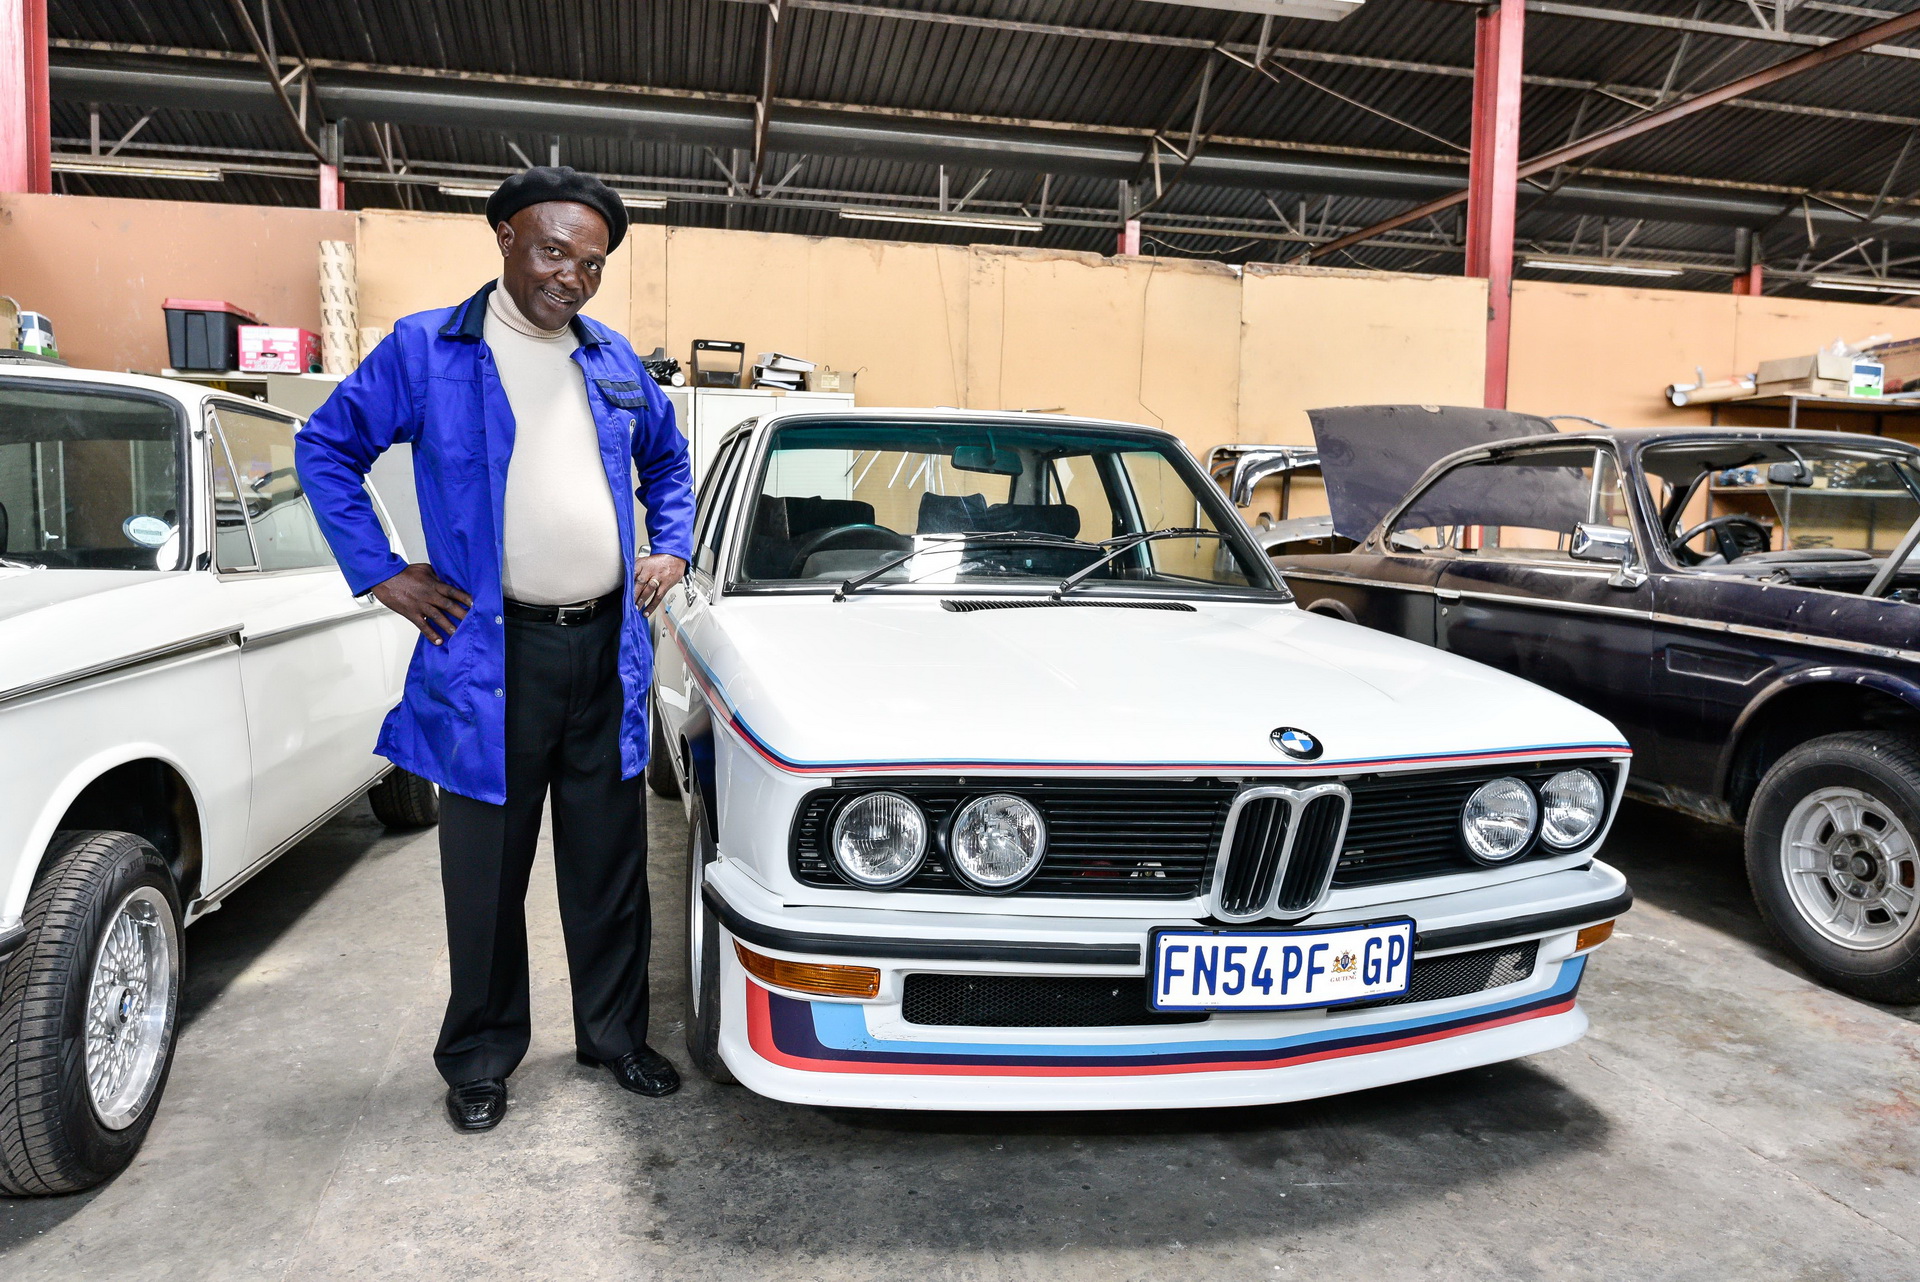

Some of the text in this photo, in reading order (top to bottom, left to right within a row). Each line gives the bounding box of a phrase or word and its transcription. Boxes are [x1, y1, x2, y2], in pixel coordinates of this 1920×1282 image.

[1162, 934, 1406, 996] FN54PF GP
[1329, 974, 1357, 983] GAUTENG
